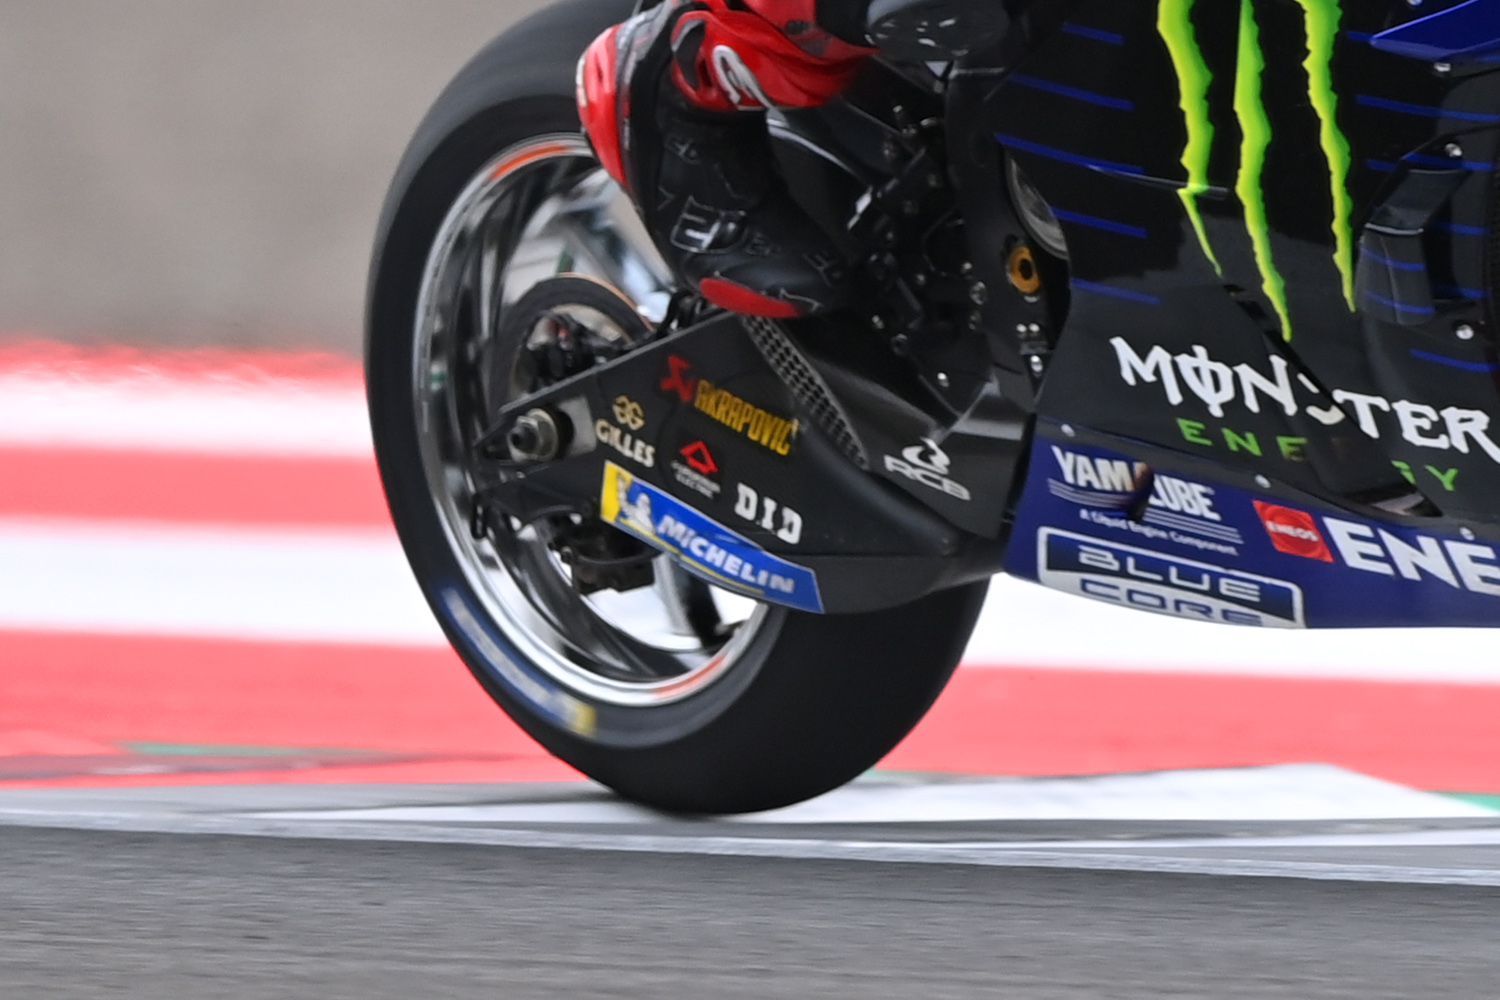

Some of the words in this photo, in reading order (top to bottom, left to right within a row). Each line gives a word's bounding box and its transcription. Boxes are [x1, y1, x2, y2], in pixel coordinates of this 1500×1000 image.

[595, 418, 656, 468] GILLES
[1177, 418, 1458, 491] ENEY
[883, 453, 971, 501] RCB
[1051, 446, 1221, 521] YAMUBE
[657, 513, 795, 594] MICHELIN
[1265, 520, 1320, 543] ENEOS
[1078, 545, 1260, 602] BLUE
[1080, 579, 1262, 627] CORE
